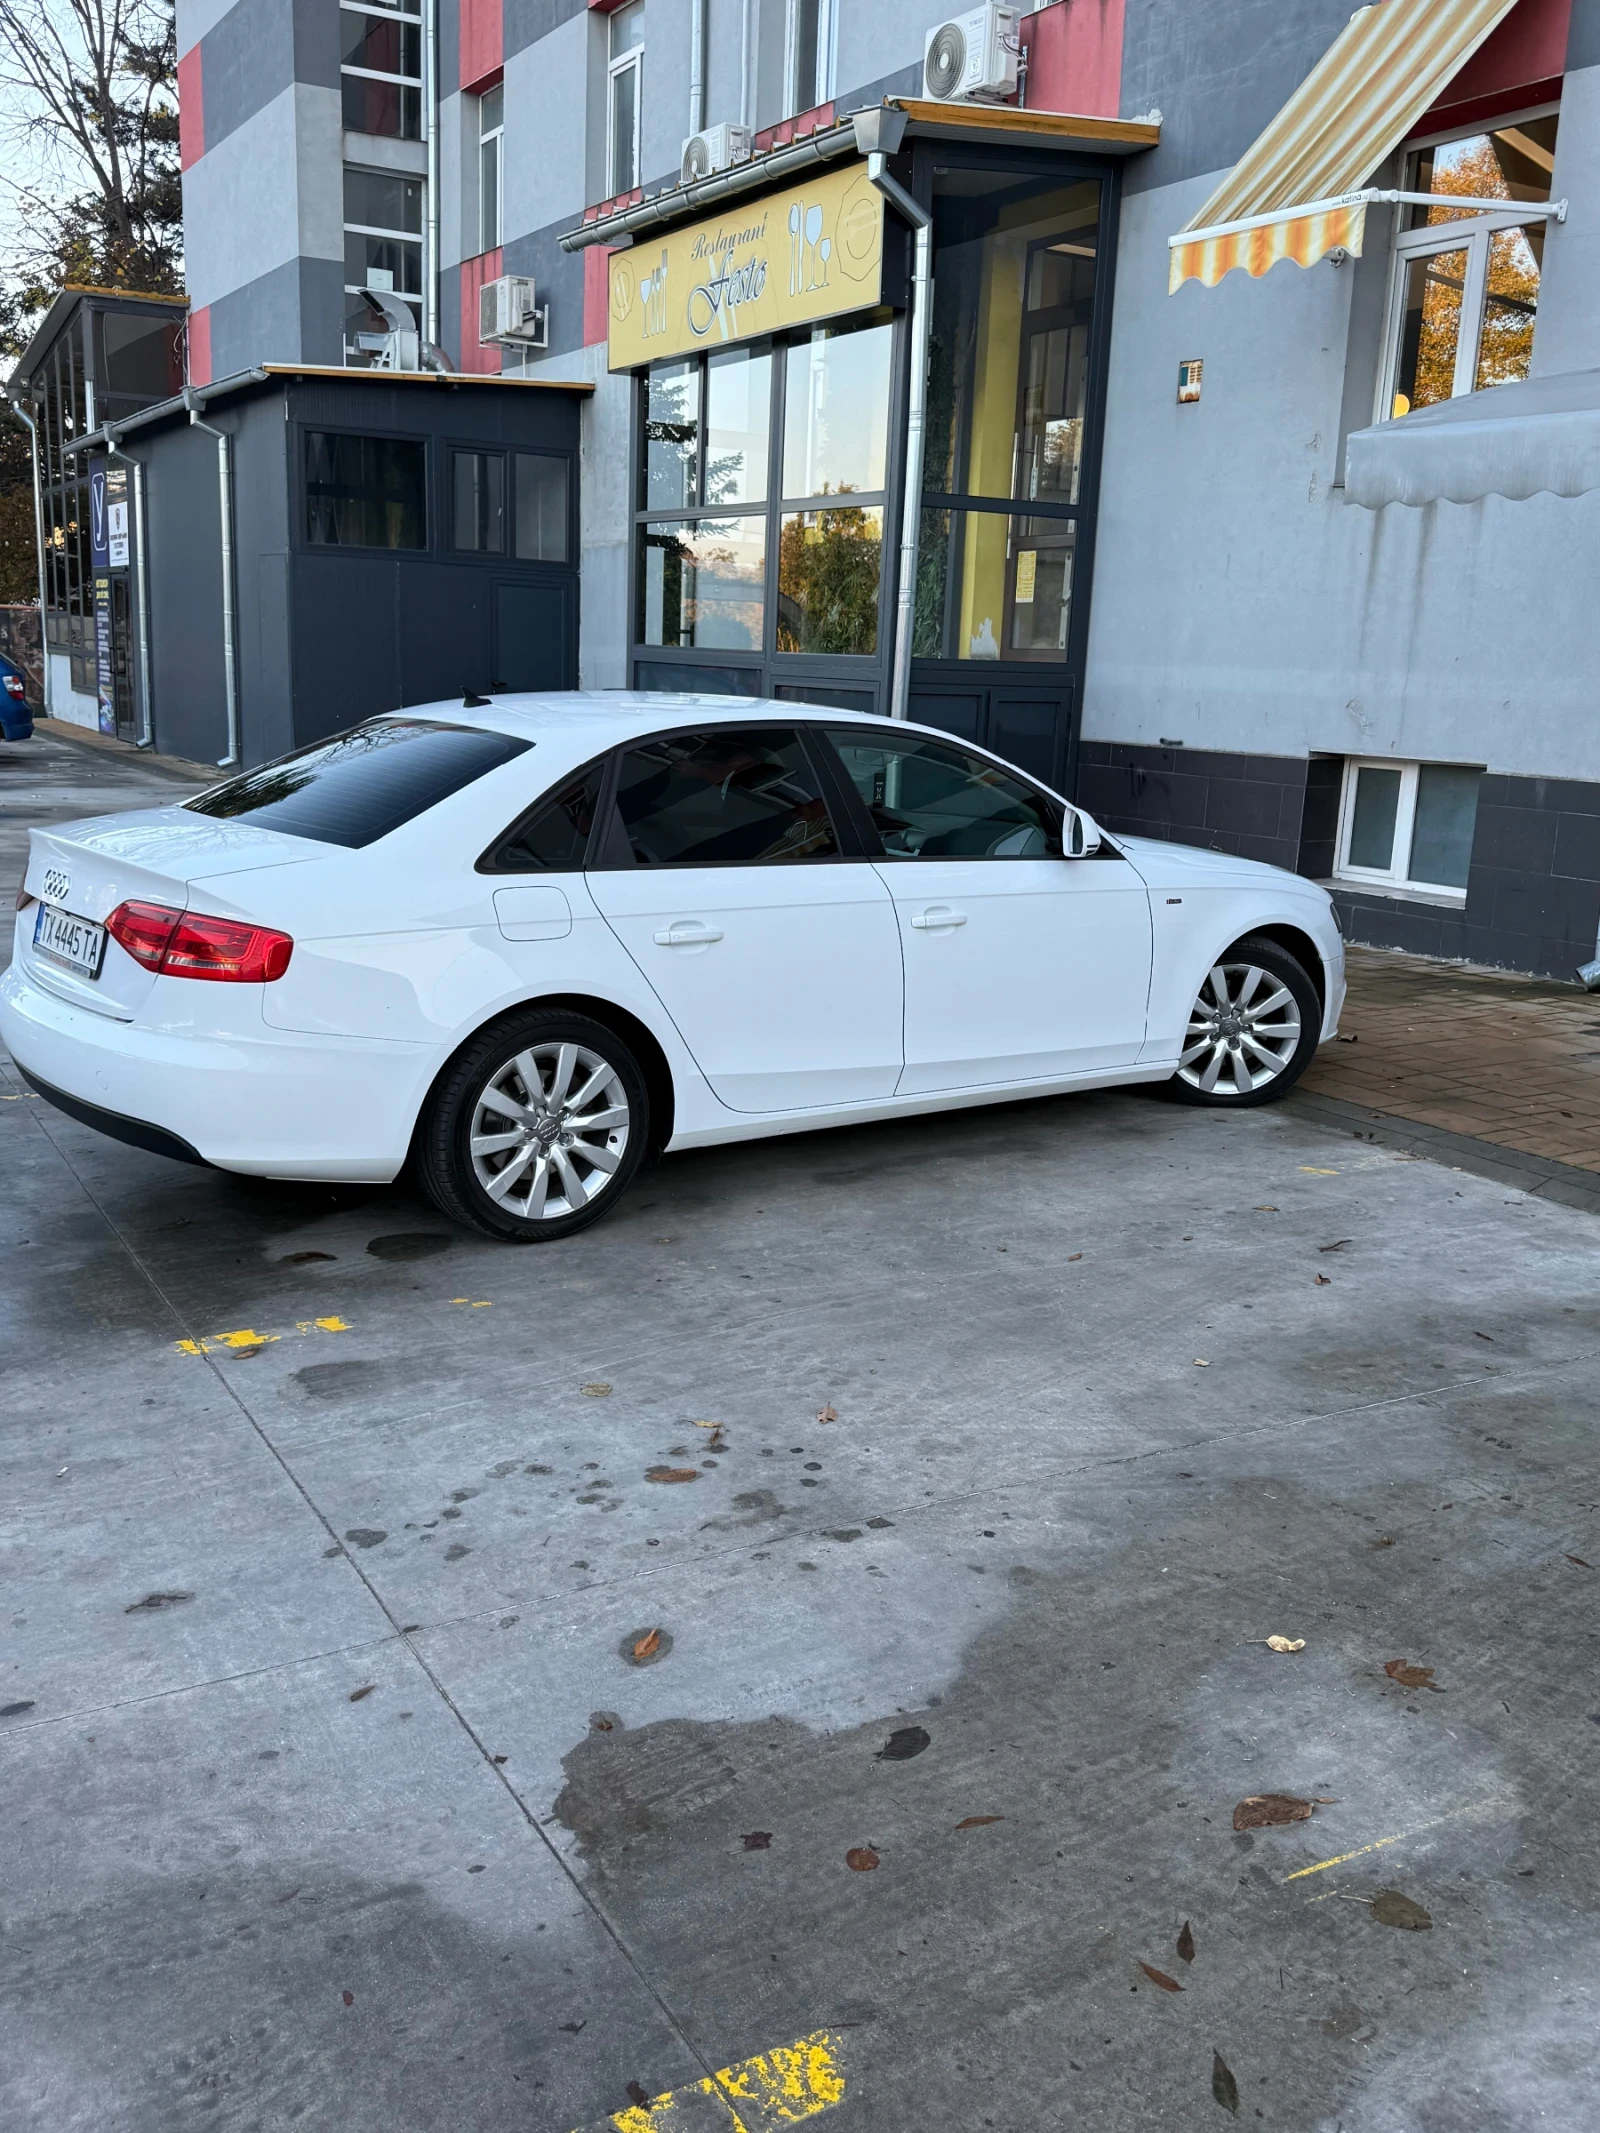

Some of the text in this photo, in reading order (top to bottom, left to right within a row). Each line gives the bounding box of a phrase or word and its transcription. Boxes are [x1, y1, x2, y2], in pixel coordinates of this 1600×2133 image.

[691, 211, 768, 261] Restaurant
[688, 247, 768, 337] Festo
[42, 911, 57, 946] TX
[54, 919, 82, 956] 4445
[82, 929, 98, 965] TA
